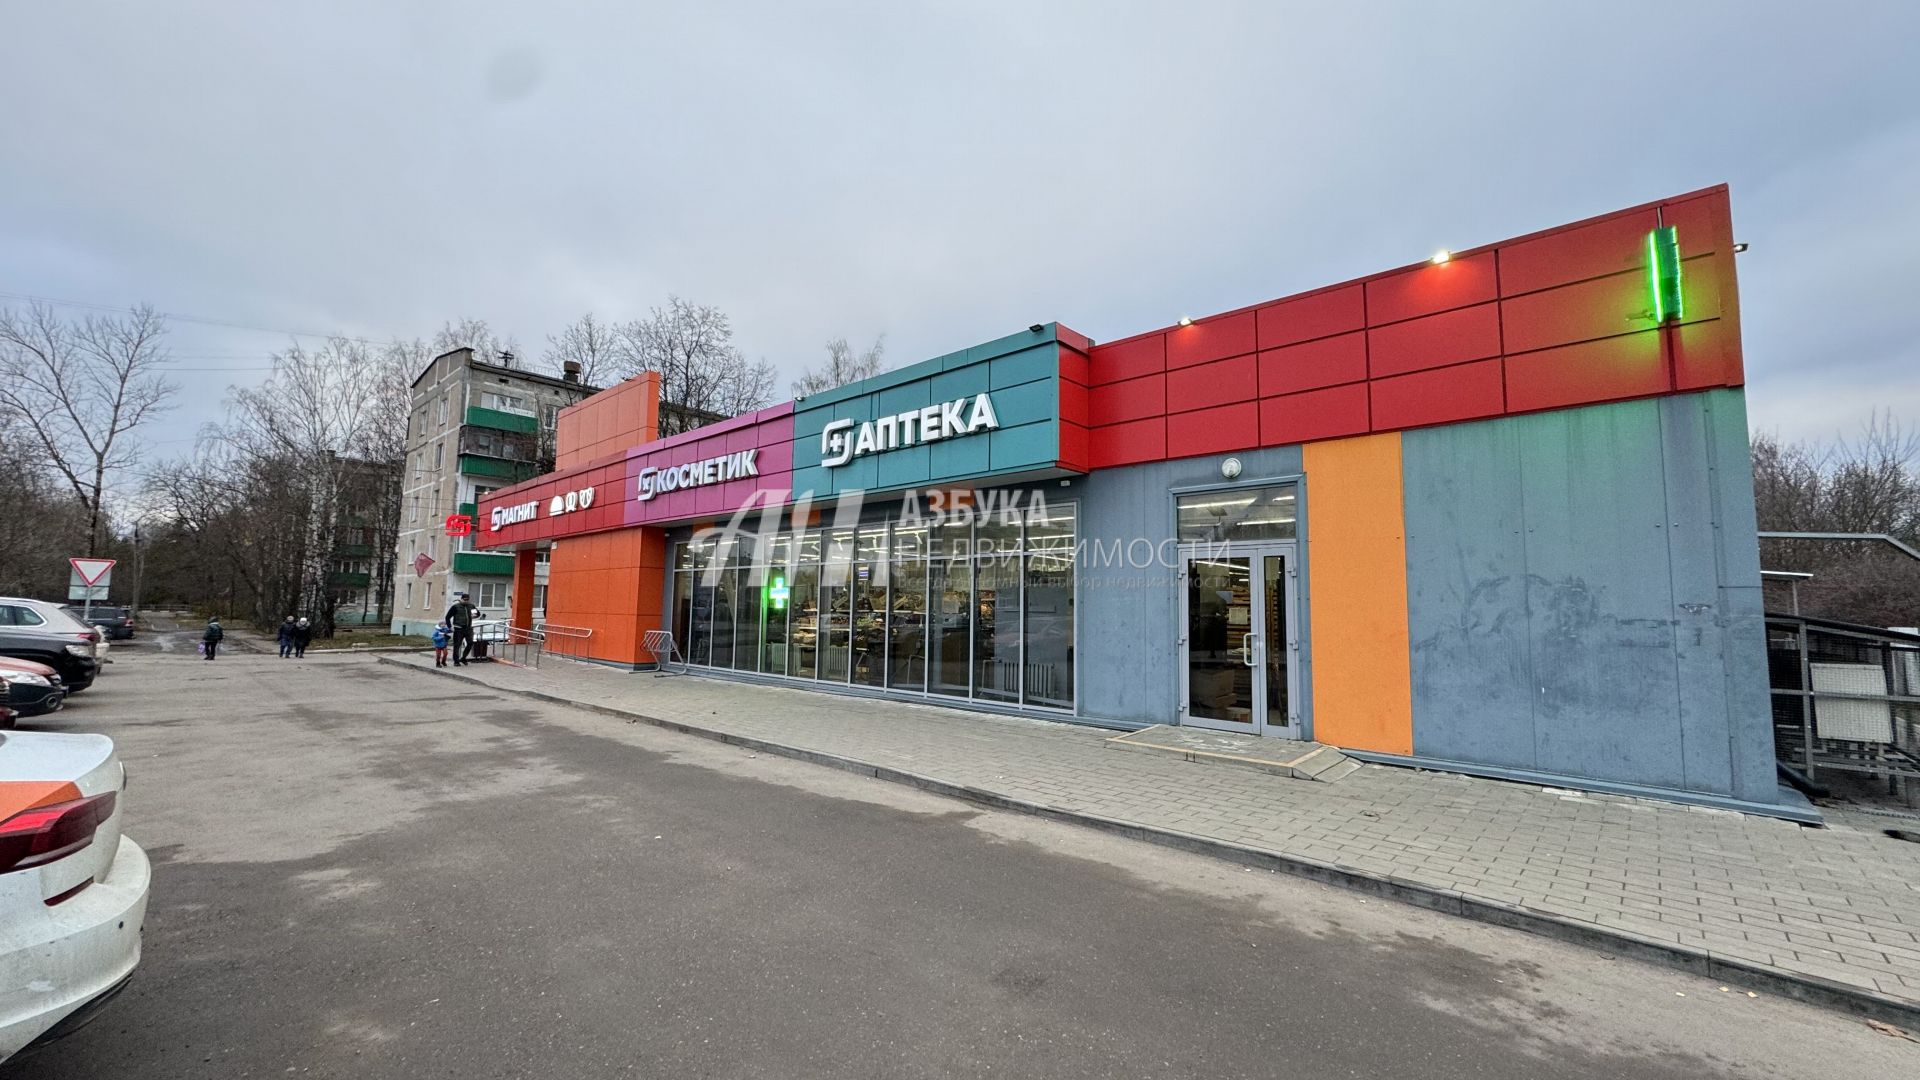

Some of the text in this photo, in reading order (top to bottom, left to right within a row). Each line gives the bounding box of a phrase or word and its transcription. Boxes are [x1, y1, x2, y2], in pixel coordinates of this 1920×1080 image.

[854, 393, 1000, 456] АПТЕКА
[656, 448, 759, 494] КОСМЕТИК
[501, 500, 540, 526] МАГНИТ
